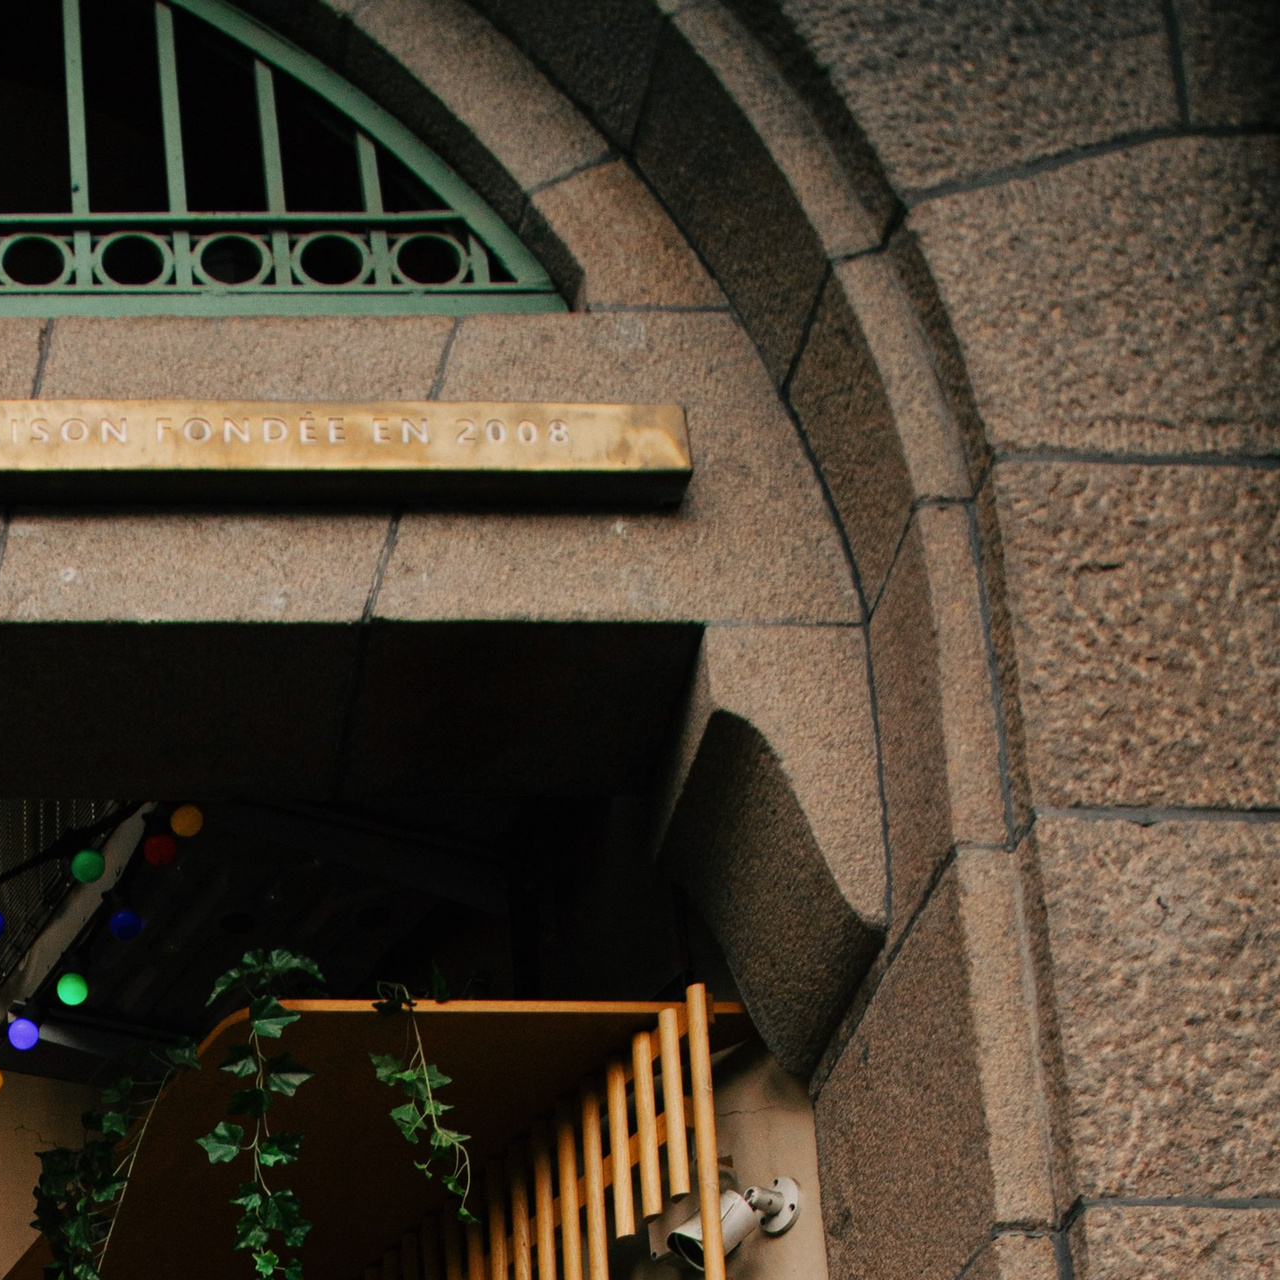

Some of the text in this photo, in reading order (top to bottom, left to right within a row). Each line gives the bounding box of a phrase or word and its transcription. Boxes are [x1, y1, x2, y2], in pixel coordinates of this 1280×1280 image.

[154, 411, 347, 444] FONDÉE
[371, 417, 430, 445] EN
[455, 418, 570, 445] 2008
